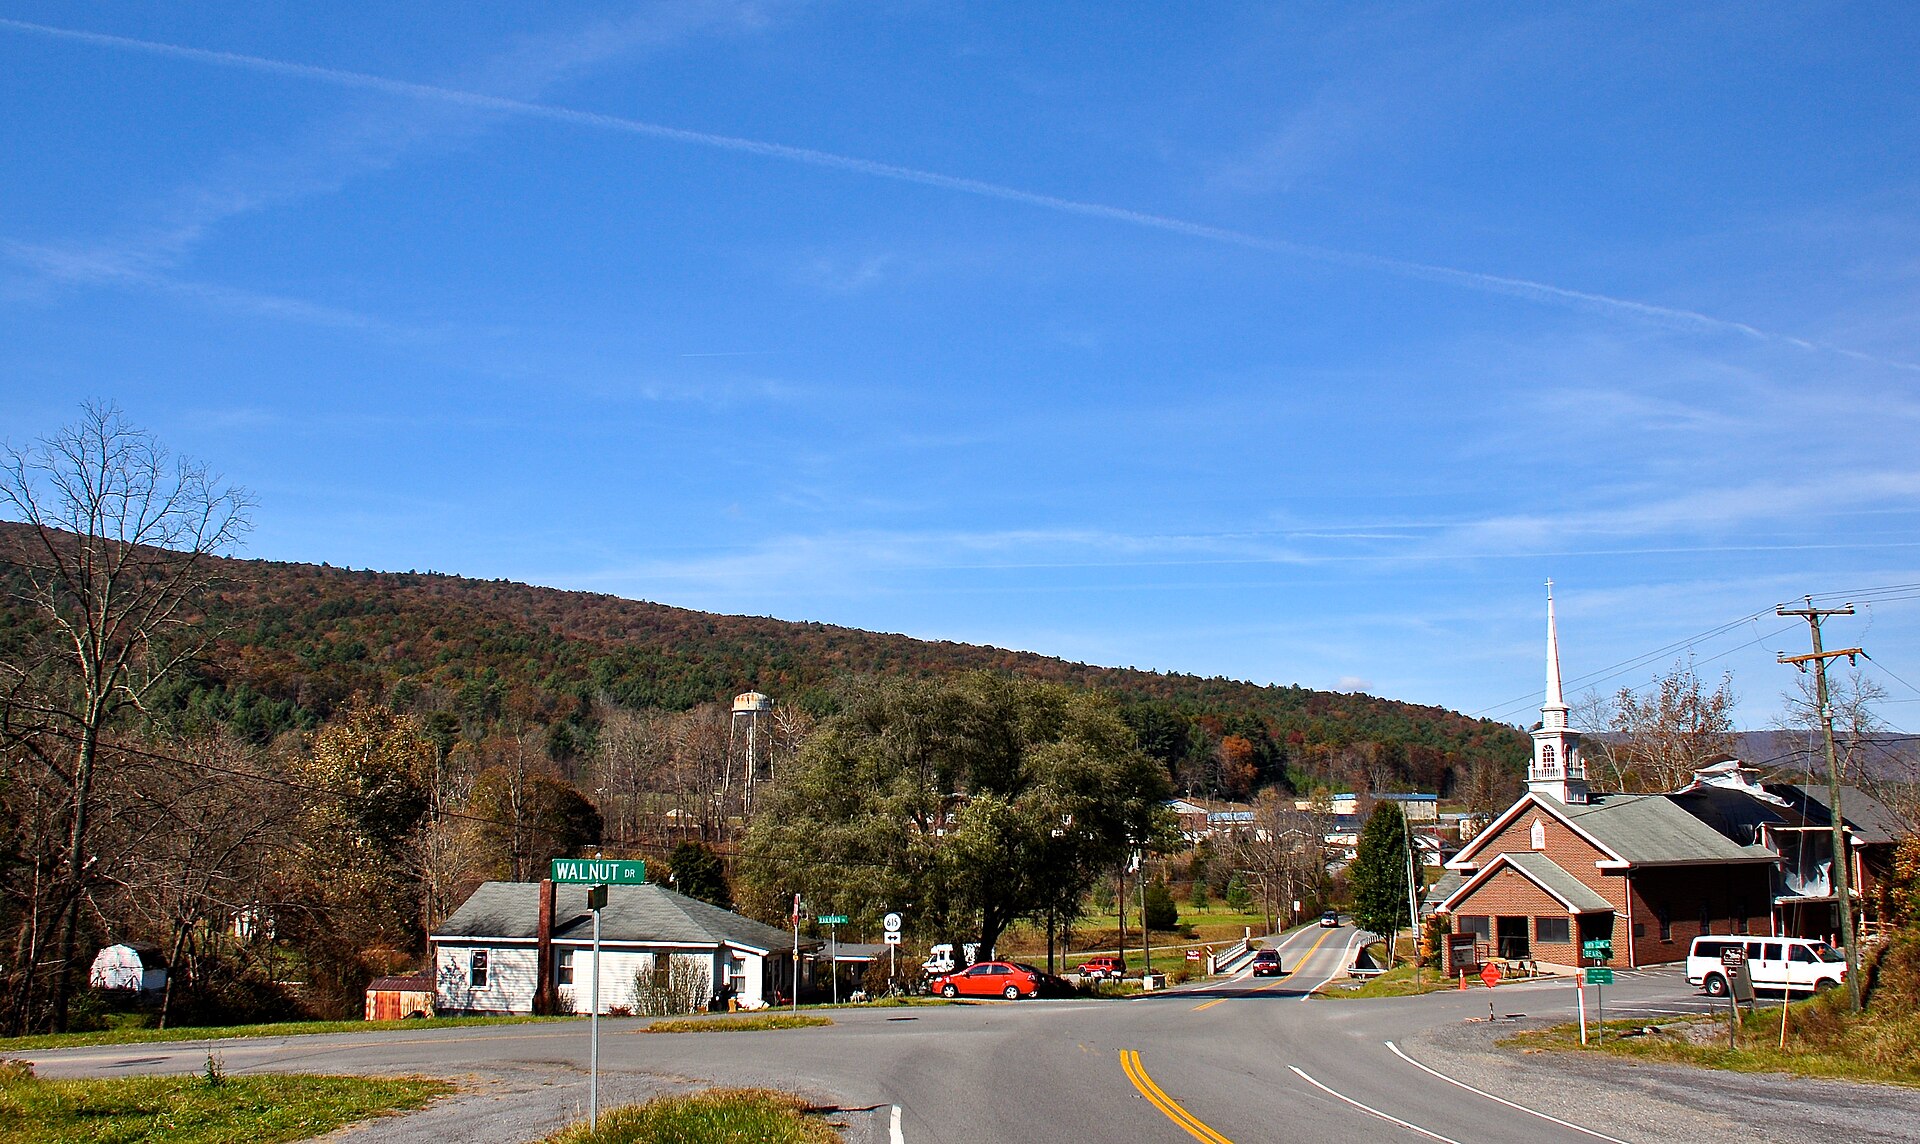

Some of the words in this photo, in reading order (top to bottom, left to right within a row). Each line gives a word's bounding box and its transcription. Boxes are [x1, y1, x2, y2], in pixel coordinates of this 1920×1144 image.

[556, 862, 620, 881] WALNUT
[624, 868, 636, 878] DR
[886, 917, 899, 927] 615
